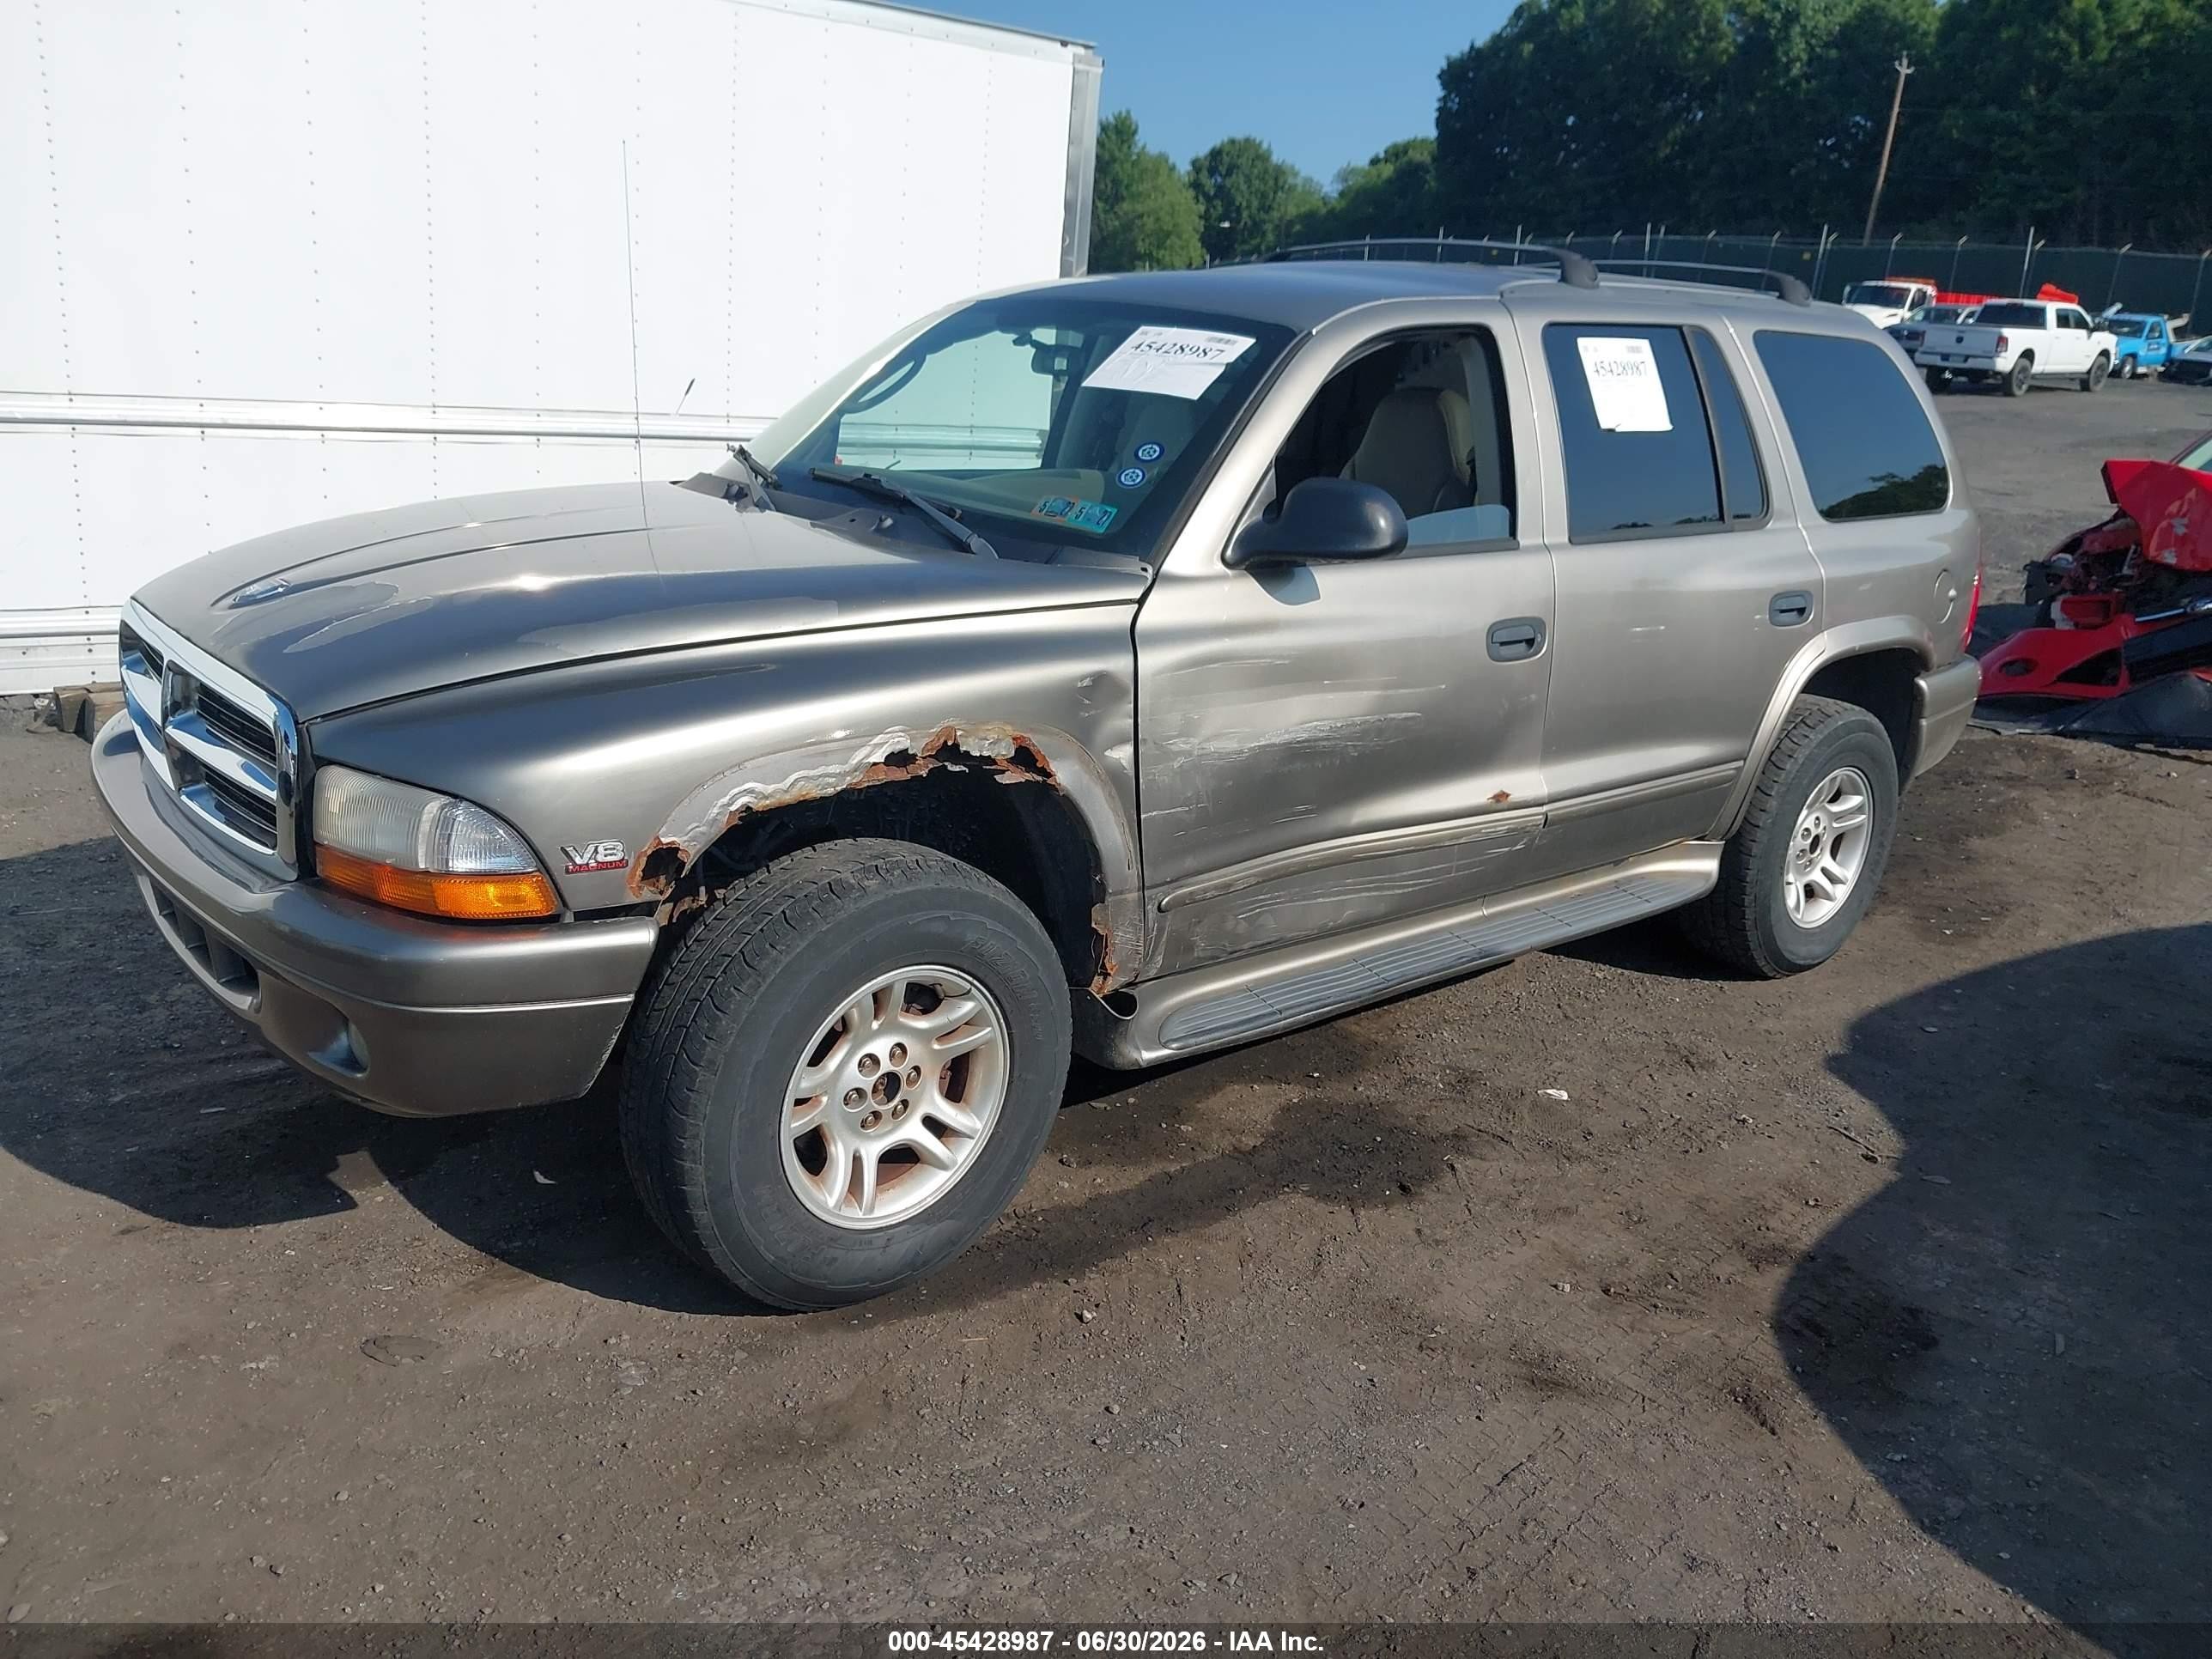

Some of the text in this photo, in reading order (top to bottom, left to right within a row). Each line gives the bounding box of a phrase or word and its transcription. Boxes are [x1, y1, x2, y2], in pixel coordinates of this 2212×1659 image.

[1131, 340, 1225, 360] 45428987
[1594, 361, 1647, 377] 45428987
[560, 840, 626, 866] V8
[568, 860, 627, 873] MAGNUM
